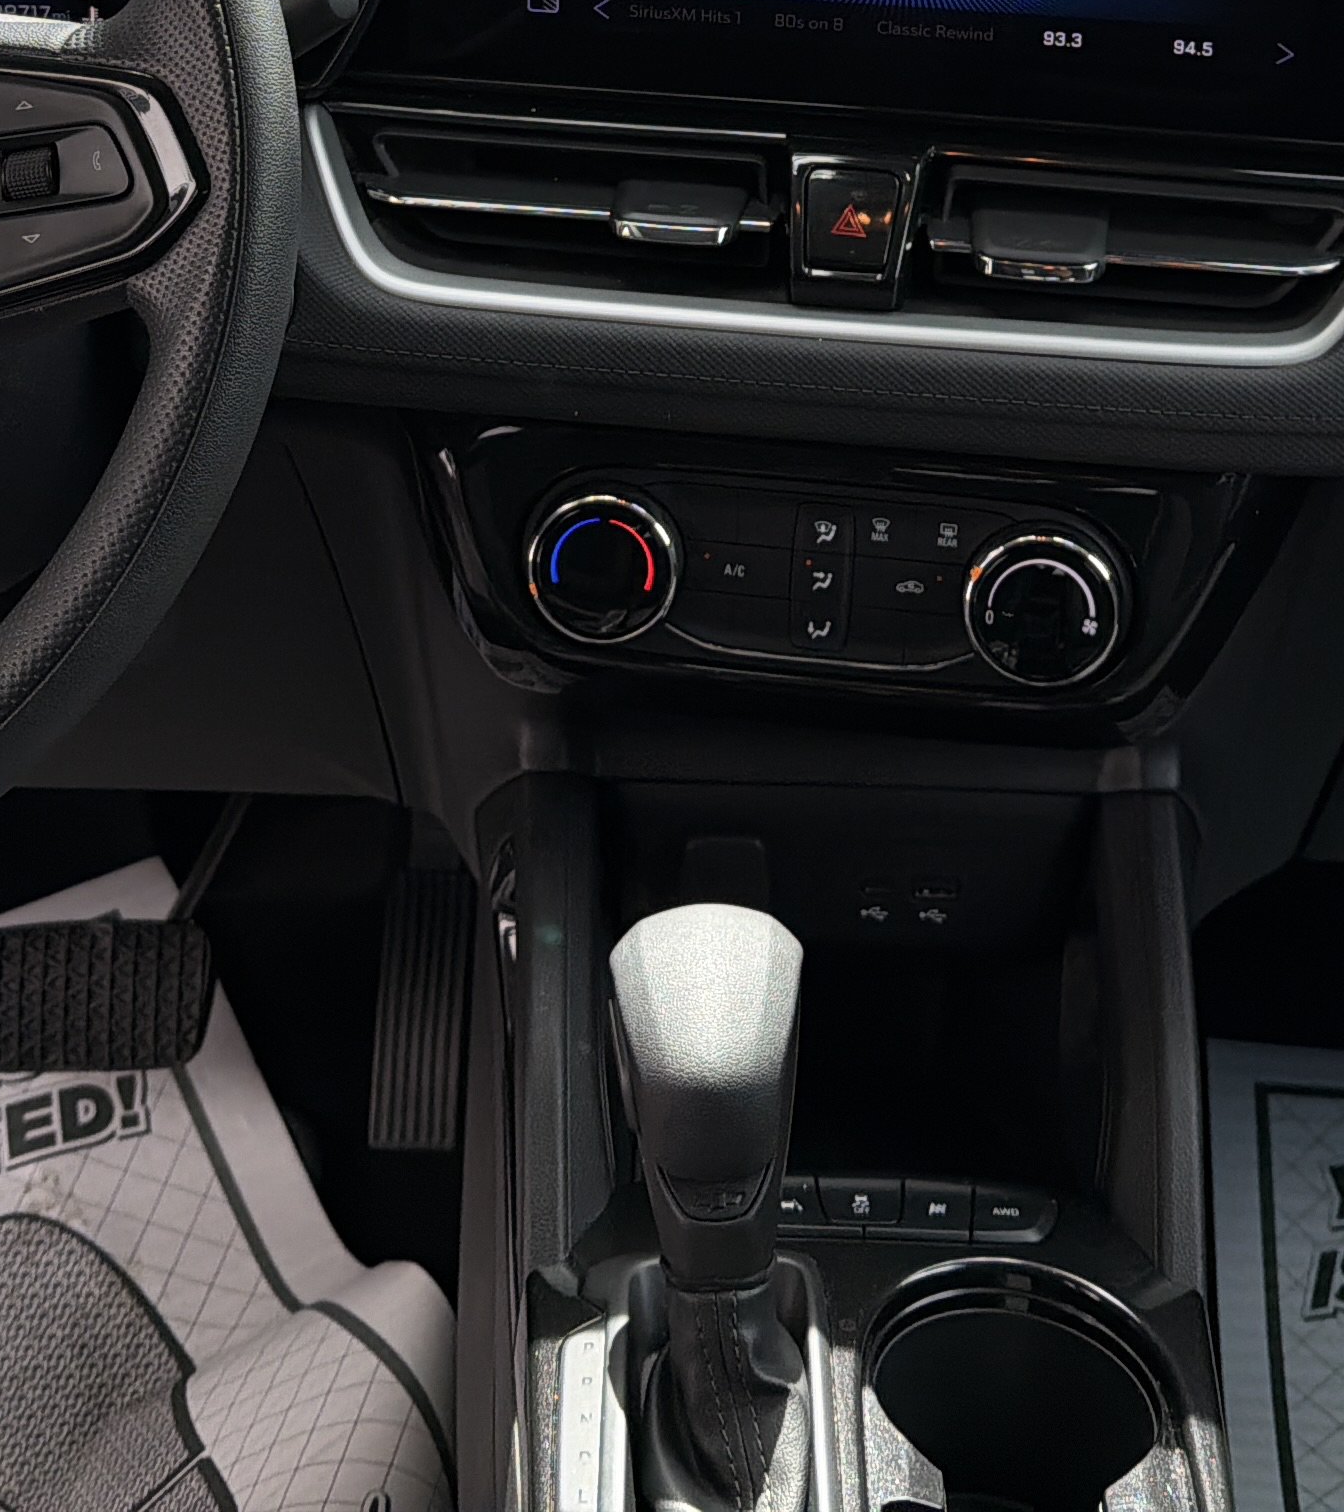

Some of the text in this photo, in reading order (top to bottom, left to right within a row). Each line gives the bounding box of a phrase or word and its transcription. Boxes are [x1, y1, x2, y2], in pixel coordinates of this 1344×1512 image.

[629, 2, 697, 22] SiriusXM
[700, 5, 731, 24] Hits
[808, 20, 828, 33] on
[877, 20, 931, 39] Classic
[935, 24, 995, 42] Rewind
[1043, 31, 1083, 48] 93.3
[1173, 40, 1214, 57] 94.5
[871, 531, 890, 544] MAX
[937, 536, 958, 549] REAR
[723, 563, 746, 579] A/C
[992, 1206, 1020, 1217] AWD
[577, 1488, 589, 1504] L
